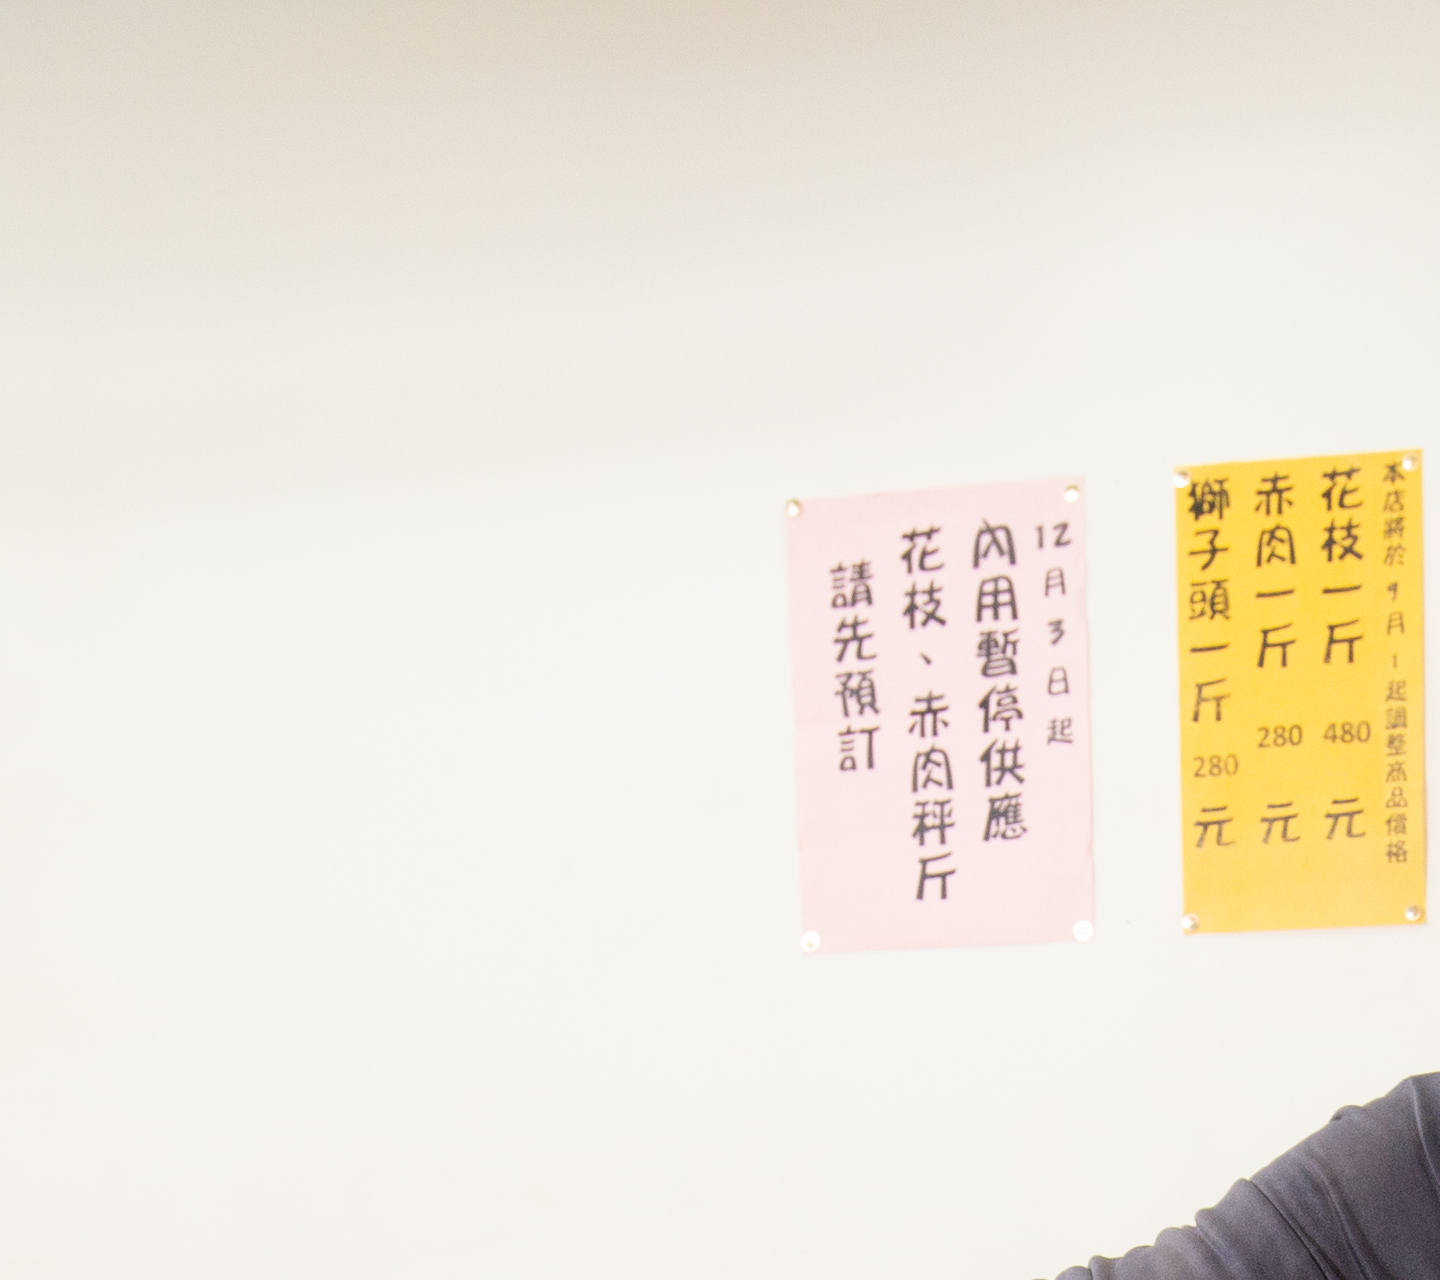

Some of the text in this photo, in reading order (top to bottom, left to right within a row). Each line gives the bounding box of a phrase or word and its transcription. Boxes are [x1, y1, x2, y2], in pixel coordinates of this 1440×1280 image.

[830, 561, 880, 772] 請先預訂
[1036, 521, 1073, 746] 12月3日起
